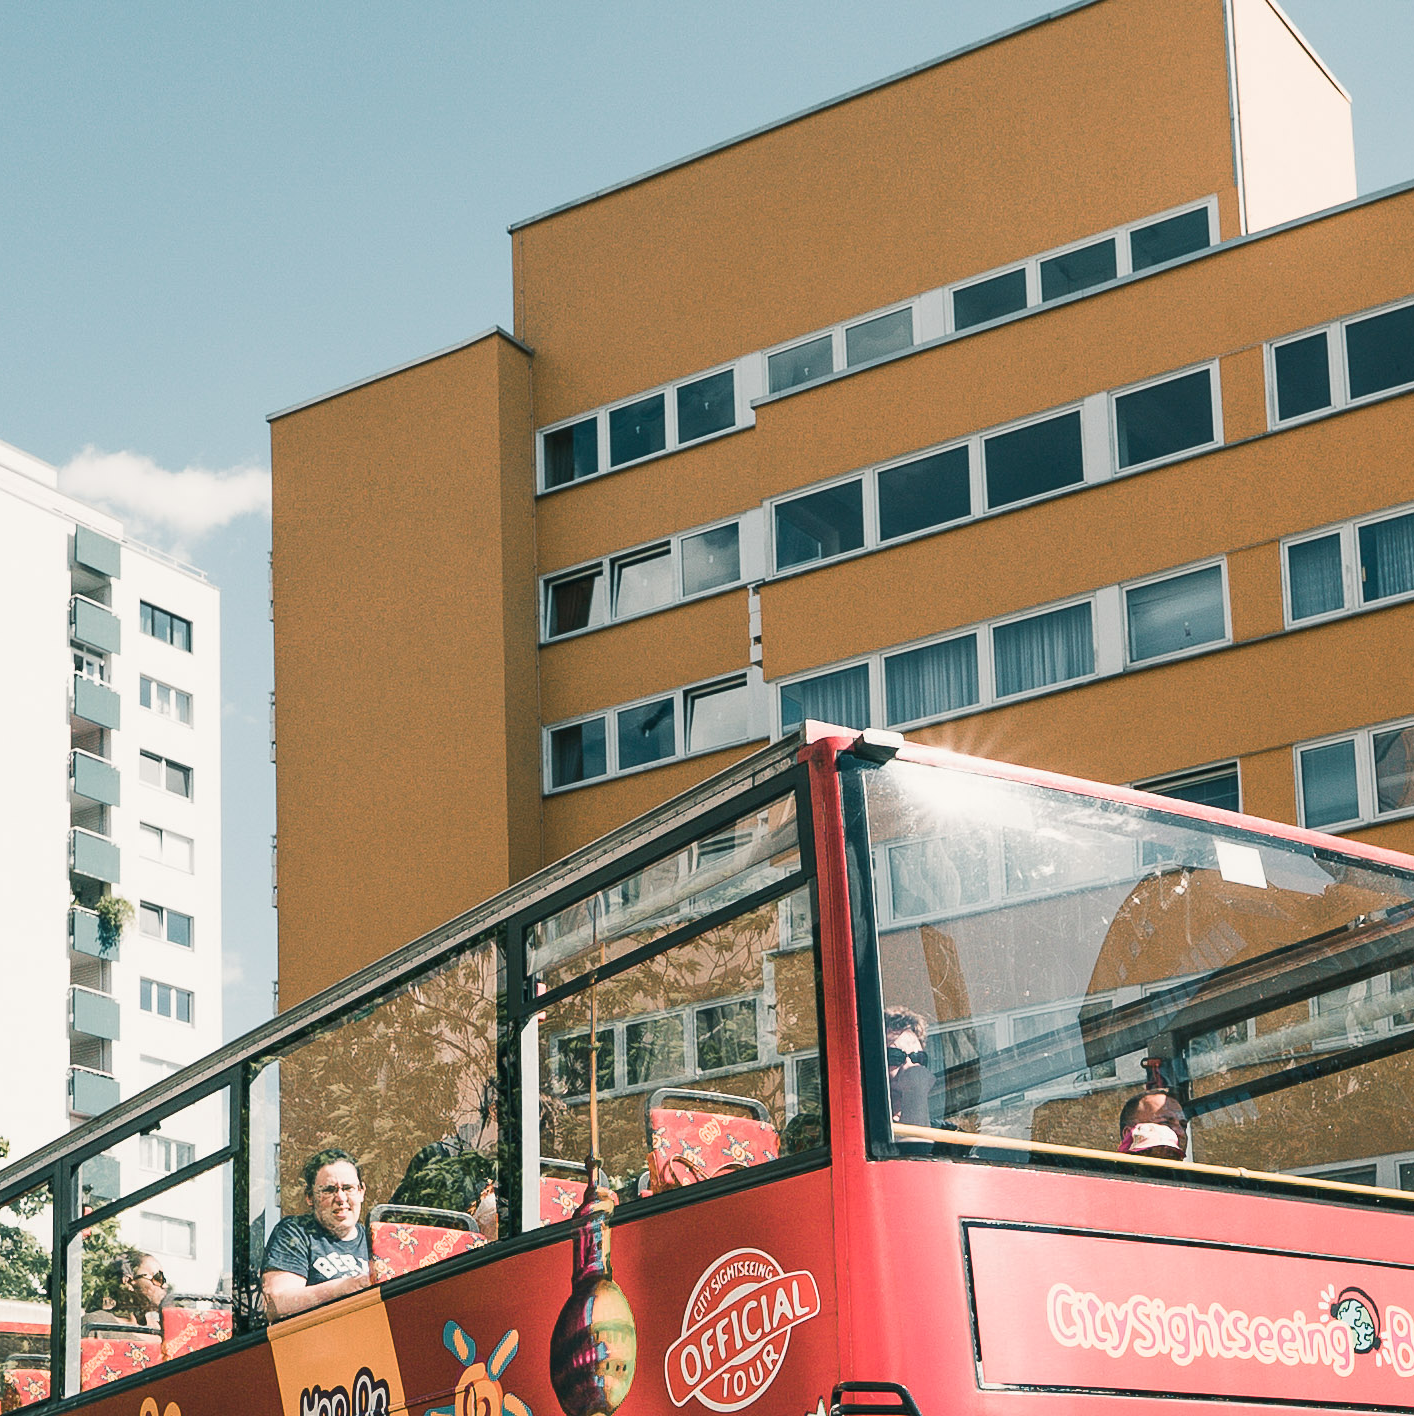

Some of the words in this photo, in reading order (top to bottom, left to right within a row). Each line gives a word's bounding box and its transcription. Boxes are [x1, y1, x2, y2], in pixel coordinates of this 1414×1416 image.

[693, 1285, 712, 1321] CITY
[710, 1260, 774, 1295] SIGHTSEEING
[680, 1279, 810, 1386] OFFICIAL
[722, 1343, 780, 1398] TOUR
